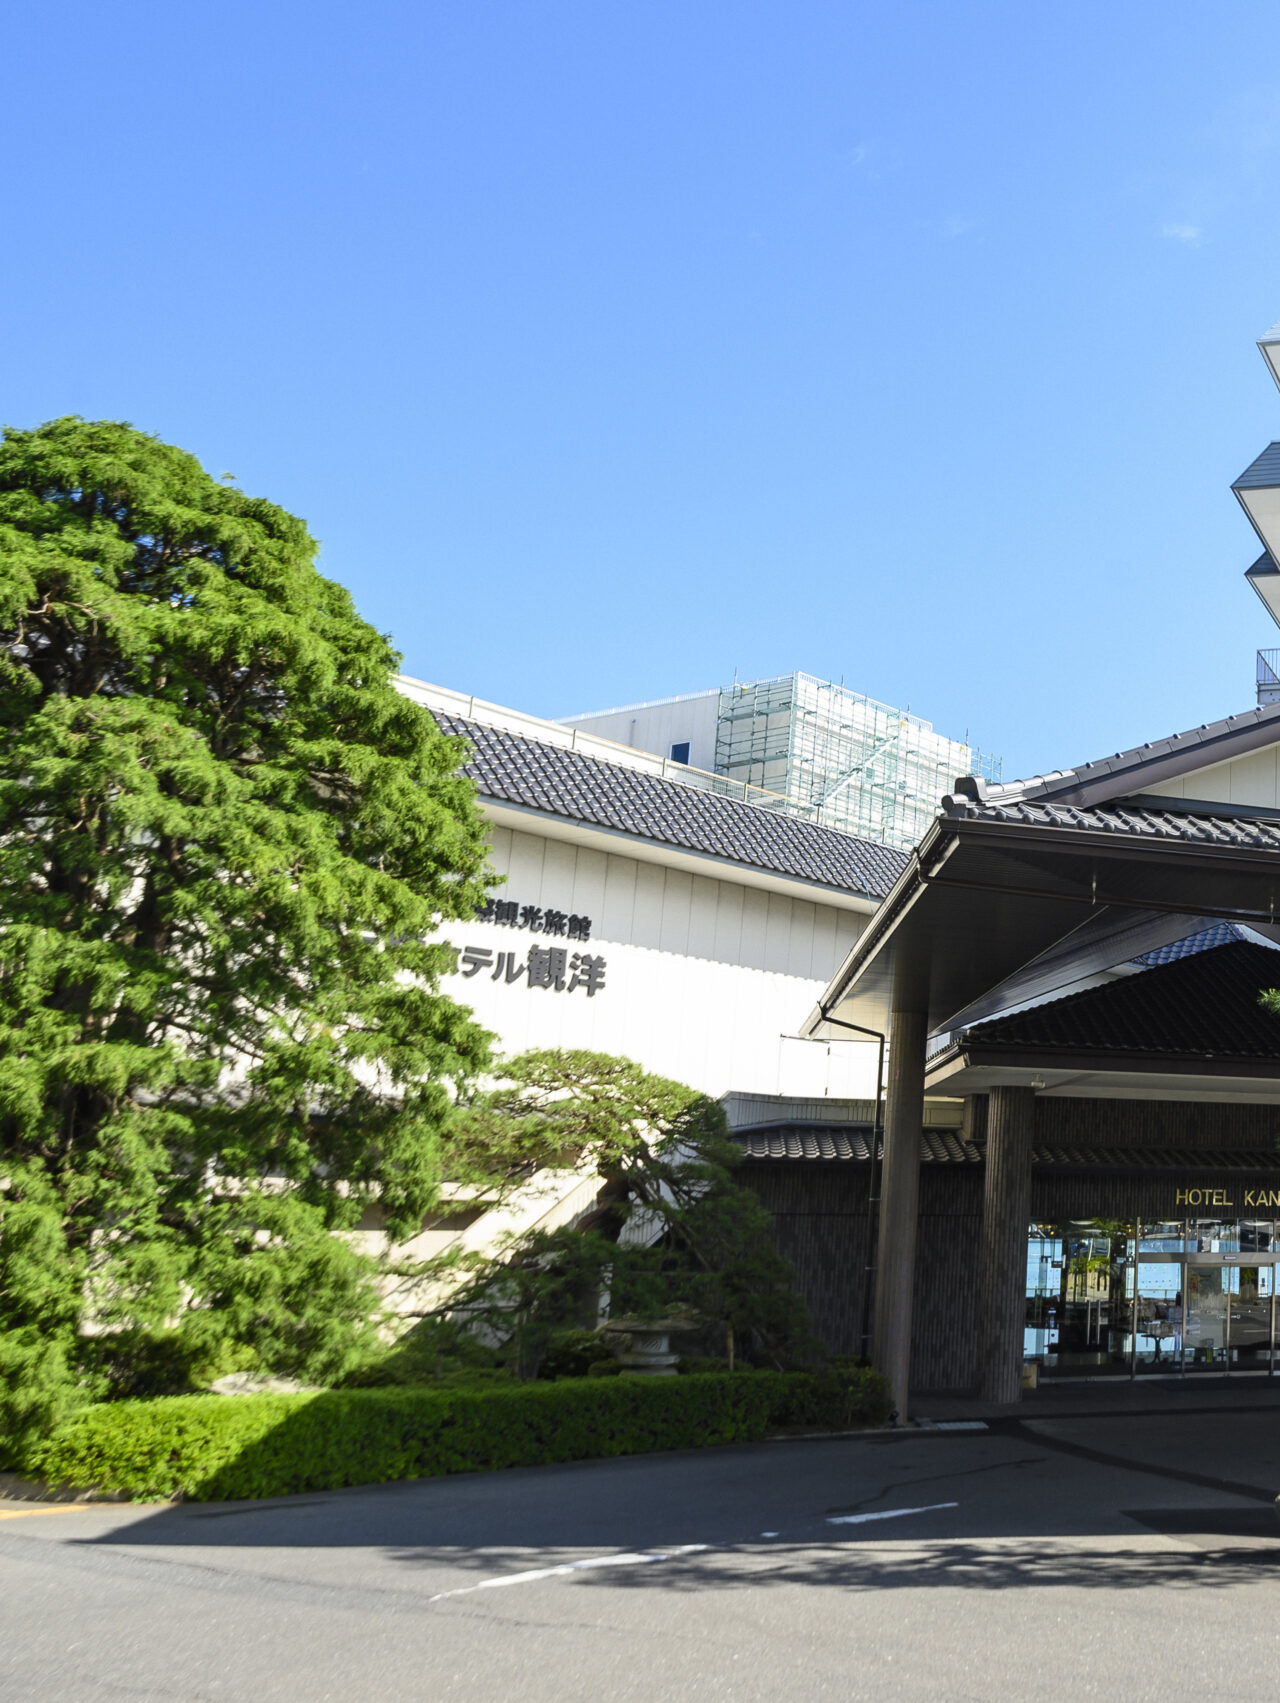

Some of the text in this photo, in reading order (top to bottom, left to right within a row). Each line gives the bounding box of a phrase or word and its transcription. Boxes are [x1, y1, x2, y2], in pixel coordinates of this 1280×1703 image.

[447, 943, 607, 997] テル観洋
[1175, 1188, 1234, 1206] HOTEL
